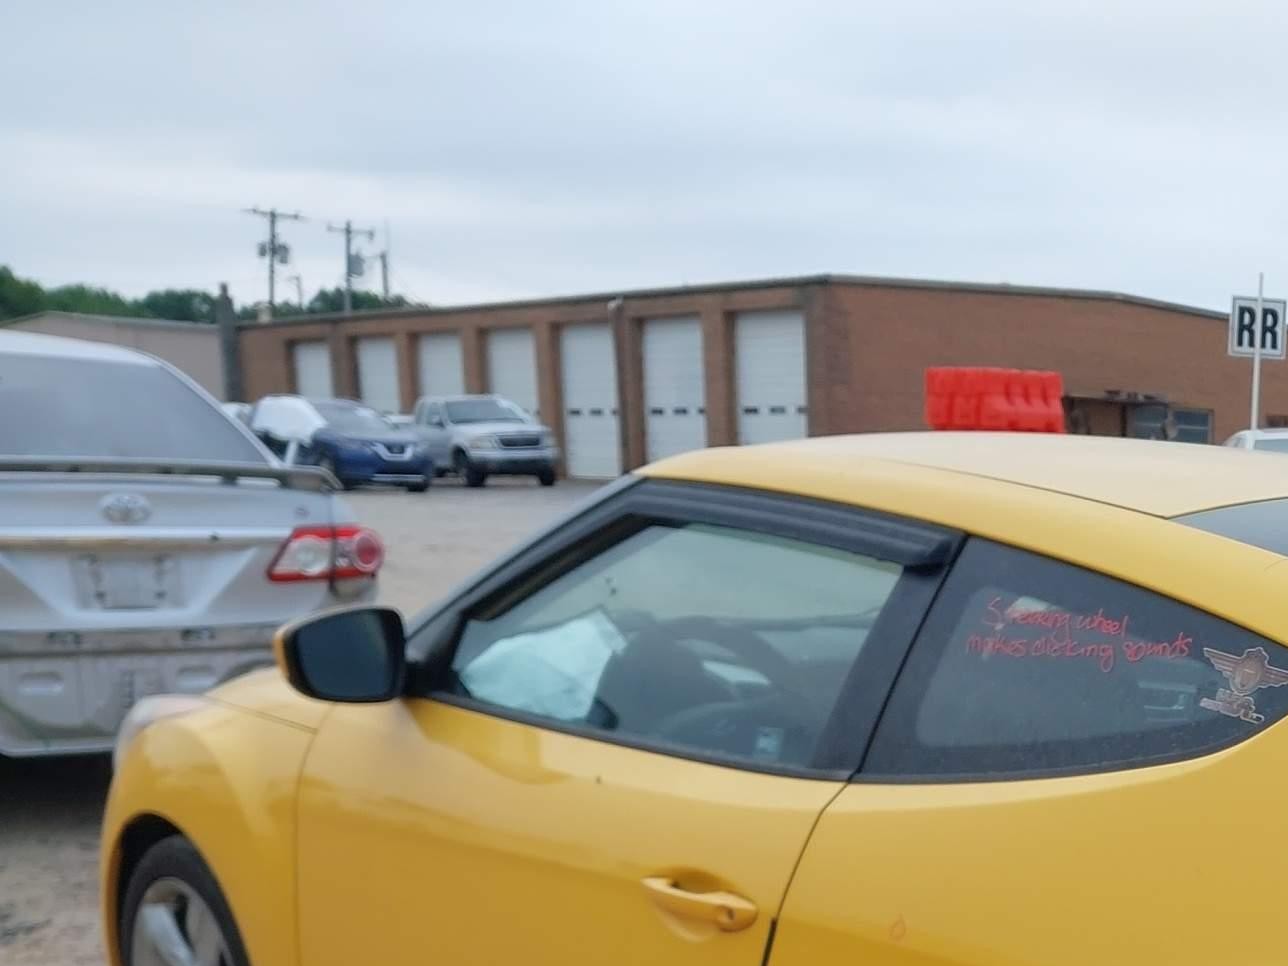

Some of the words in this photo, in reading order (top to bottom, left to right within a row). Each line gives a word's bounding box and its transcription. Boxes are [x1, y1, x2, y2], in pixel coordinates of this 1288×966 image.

[1237, 305, 1279, 350] RR
[1074, 608, 1128, 638] wheel
[966, 633, 1027, 658] makes
[1122, 631, 1193, 662] sounds
